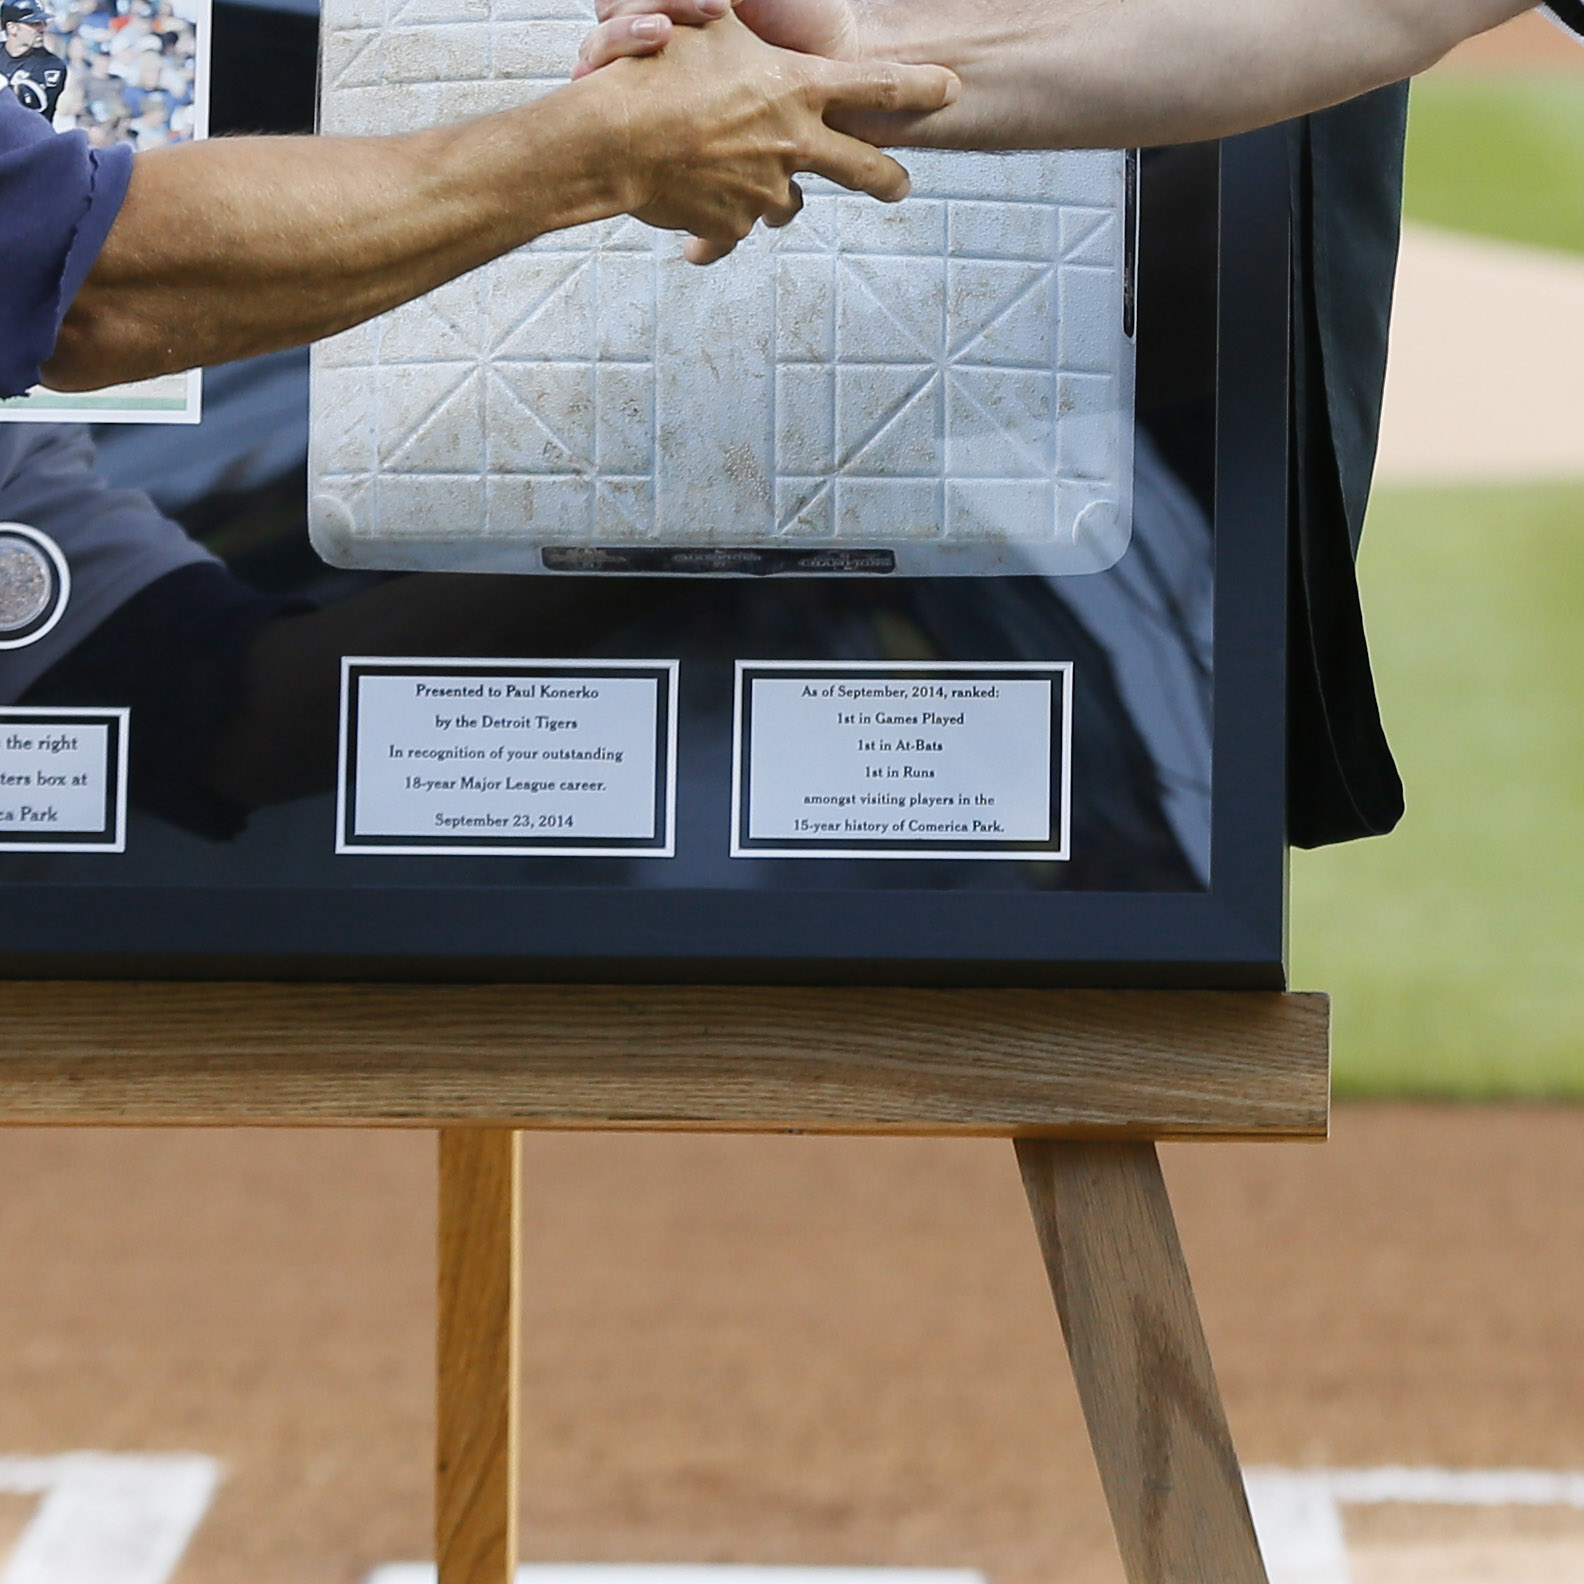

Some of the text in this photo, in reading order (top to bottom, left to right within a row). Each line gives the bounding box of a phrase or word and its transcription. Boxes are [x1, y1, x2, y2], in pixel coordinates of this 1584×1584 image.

[415, 683, 600, 699] Presented to Paul Konerko
[801, 684, 1000, 701] As of September, 2014, ranked:
[435, 714, 578, 732] by the Detroit Tigers
[837, 711, 965, 728] 1st in Games Played
[6, 734, 33, 751] the
[37, 734, 78, 754] right
[858, 738, 943, 752] 1st in At-Bats
[389, 743, 624, 763] In recognition of your outstanding
[36, 770, 67, 787] box
[71, 773, 88, 786] at
[865, 765, 935, 779] 1st in Runs
[405, 775, 606, 794] 18-year Major League career.
[803, 792, 995, 808] amongst visiting players in the
[20, 805, 58, 822] Park
[434, 812, 574, 830] September 23, 2014
[794, 818, 1005, 834] 15-year history of Comerica Park.
